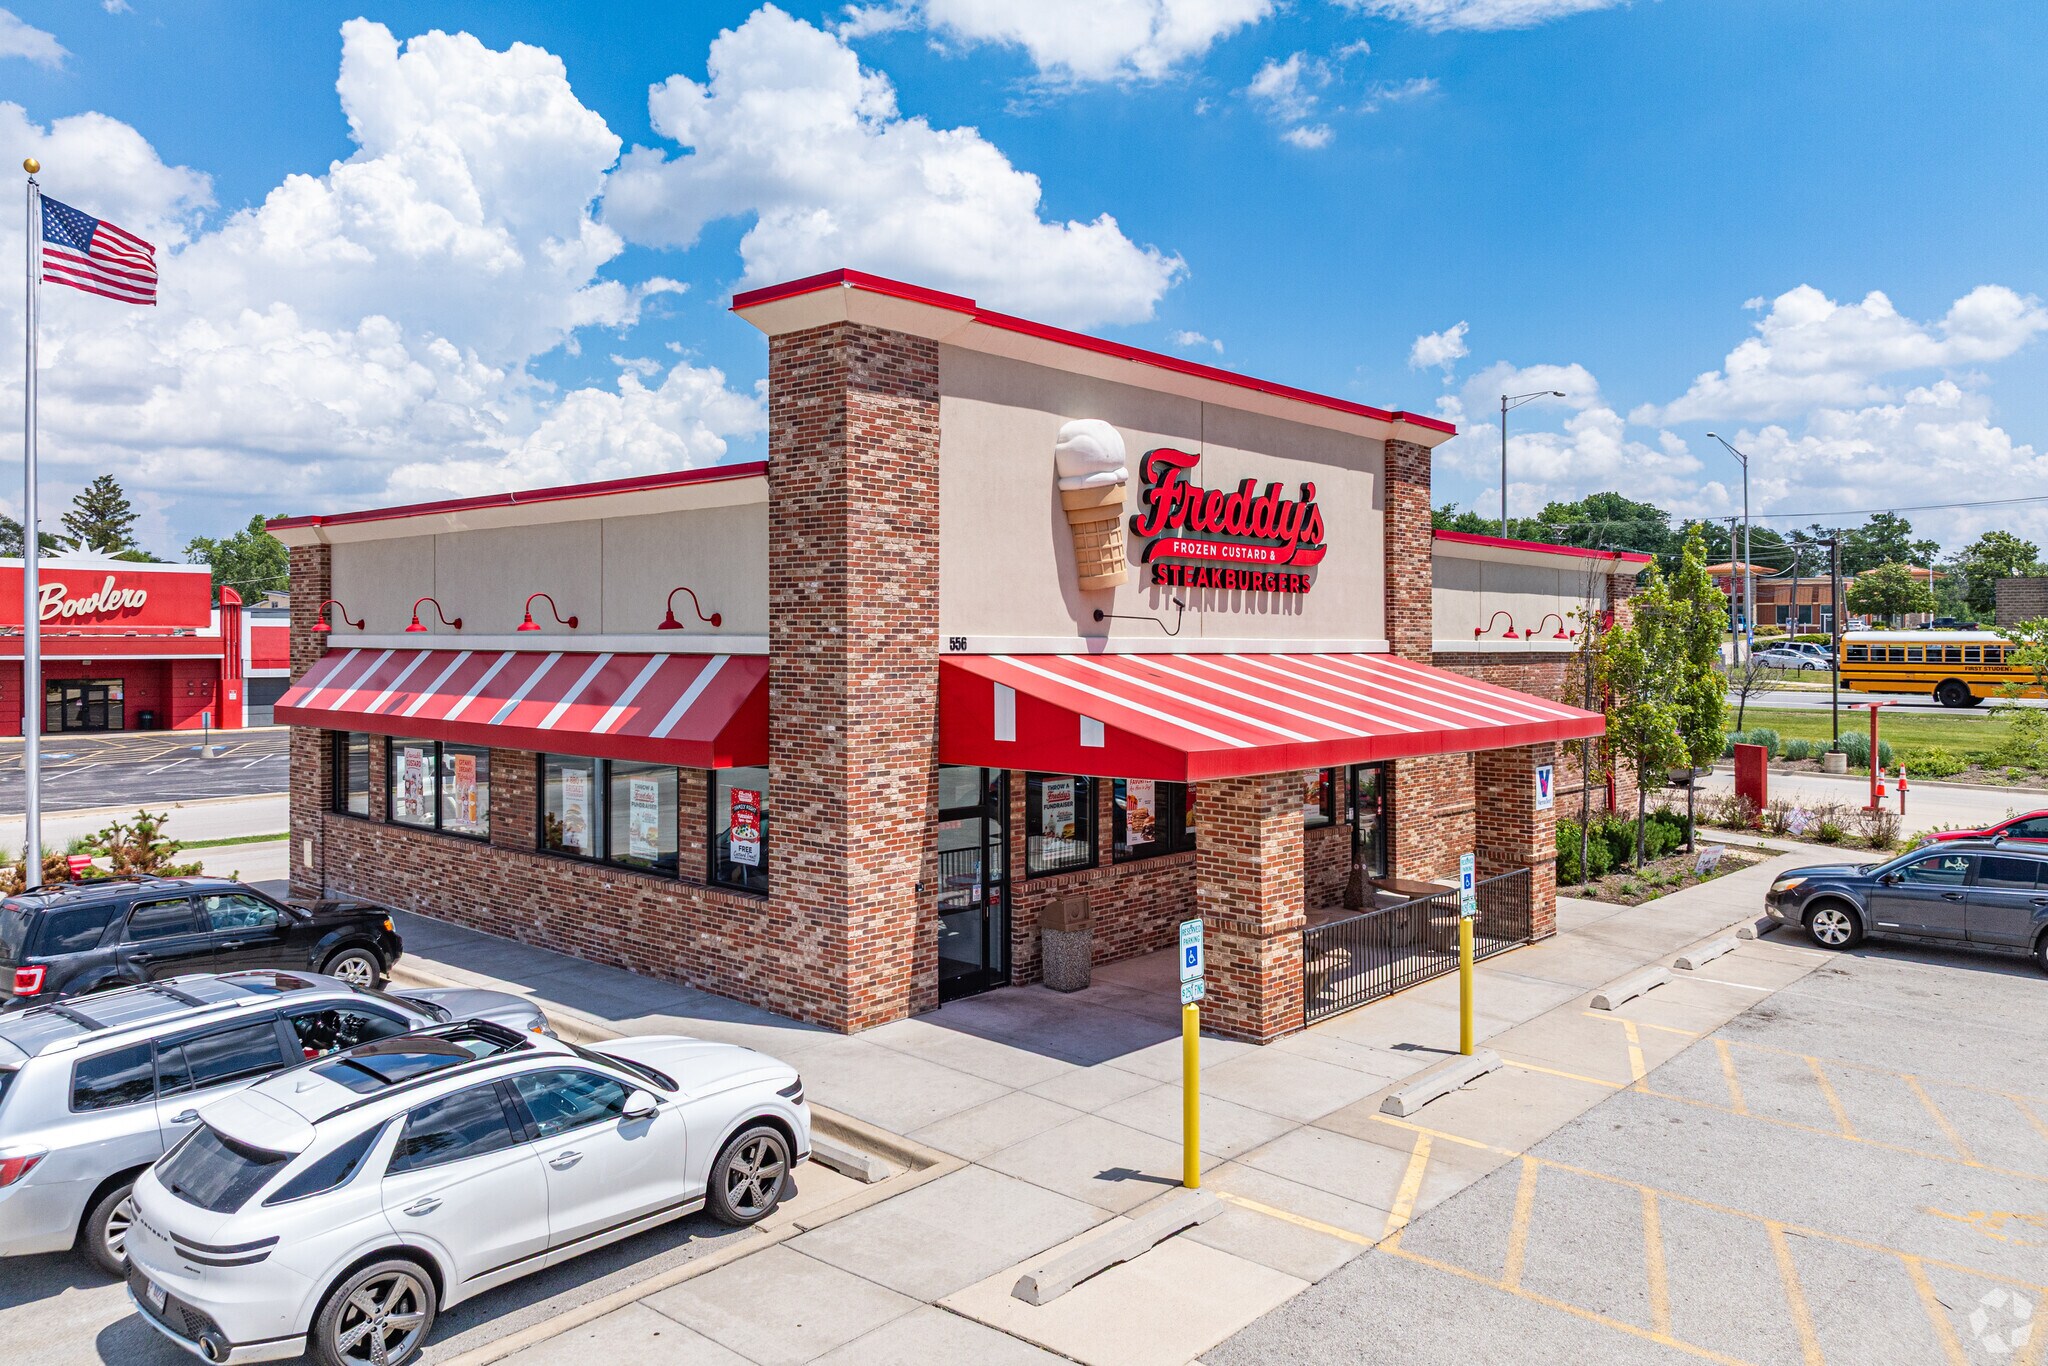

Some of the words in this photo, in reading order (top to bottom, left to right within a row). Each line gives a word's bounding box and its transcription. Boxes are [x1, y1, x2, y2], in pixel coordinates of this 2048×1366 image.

[1130, 448, 1326, 552] Freddy's
[1173, 541, 1217, 556] FROZEN
[1222, 545, 1267, 560] CUSTARD
[1269, 550, 1276, 561] &
[1156, 563, 1311, 594] STEAKBURGERS
[39, 575, 147, 621] Bowlero
[949, 636, 967, 651] 556
[634, 784, 650, 792] THROW
[1046, 790, 1070, 803] Freddy's
[631, 802, 658, 810] FUNDRAISER
[1044, 801, 1074, 810] FUNDRAISER
[738, 845, 752, 854] FREE
[1182, 925, 1201, 936] RESERVED
[1182, 935, 1200, 945] PARKING
[1194, 983, 1204, 996] FINE
